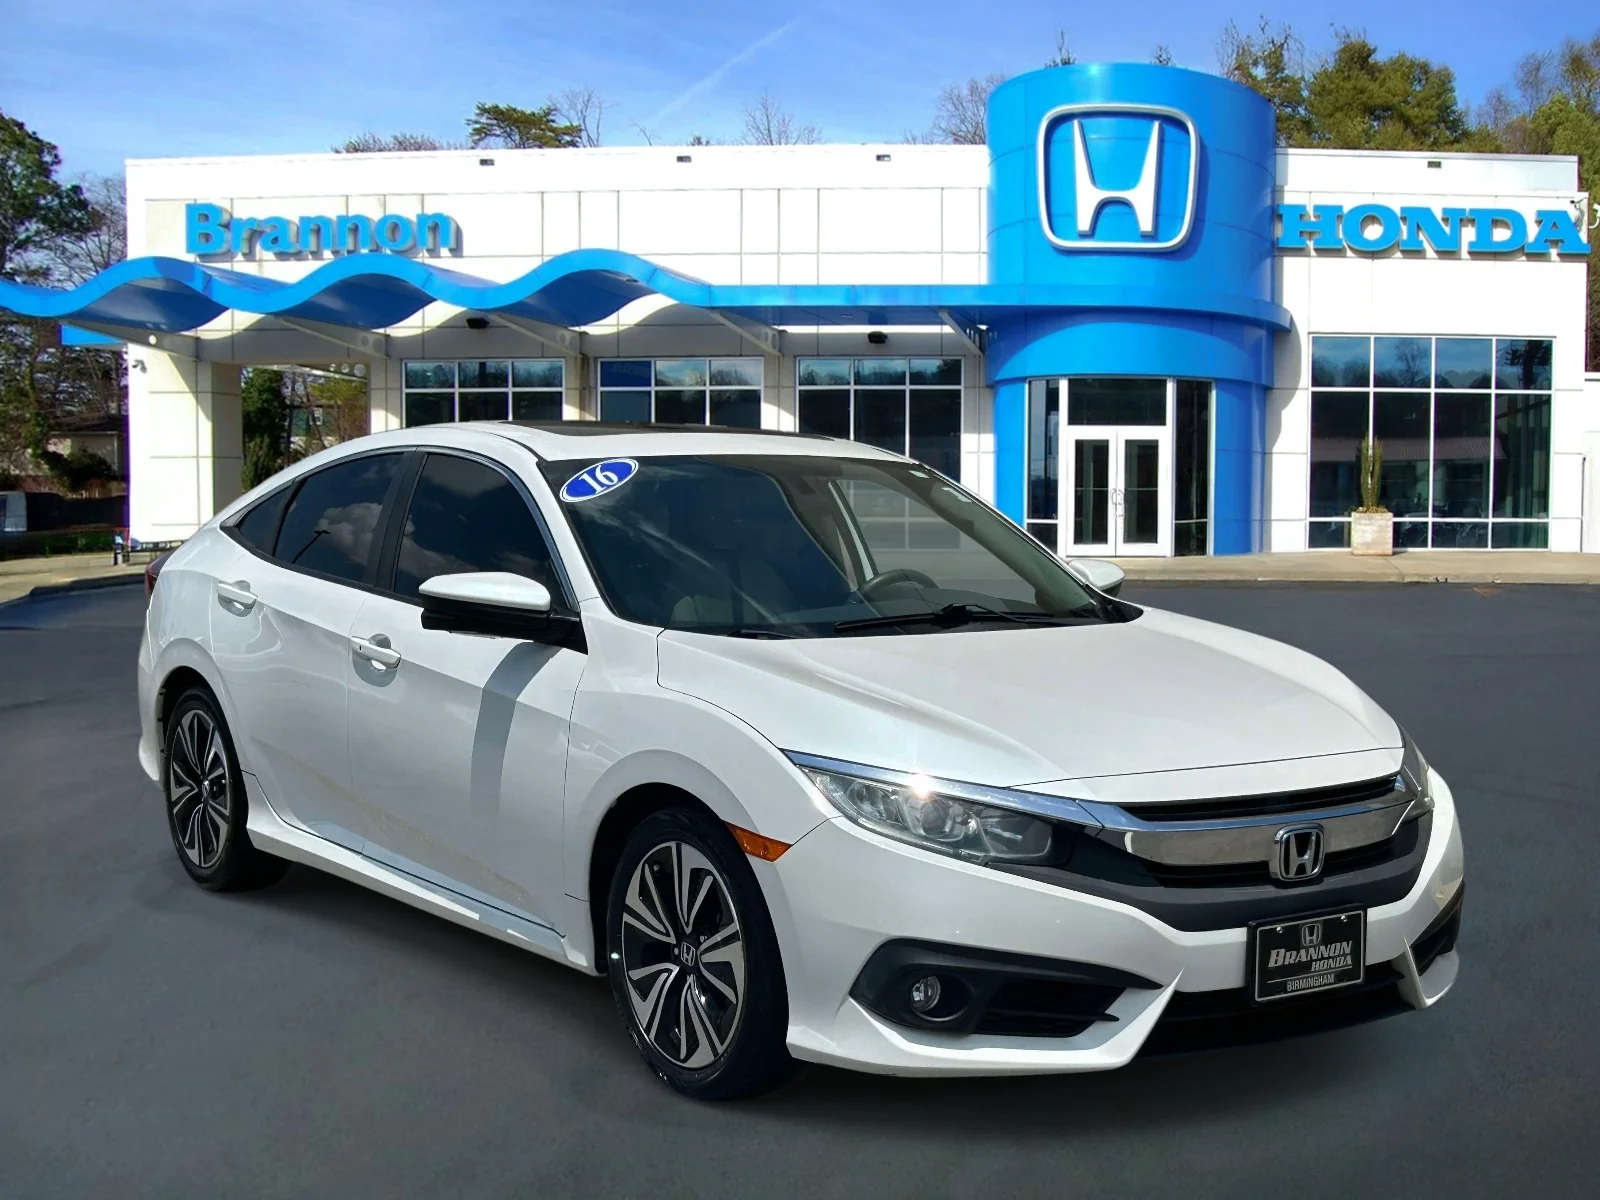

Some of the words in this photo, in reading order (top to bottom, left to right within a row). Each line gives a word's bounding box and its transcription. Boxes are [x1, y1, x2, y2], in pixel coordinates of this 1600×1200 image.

[185, 203, 459, 256] Brannon
[1277, 203, 1591, 257] HONDA
[579, 464, 618, 494] 16
[1268, 941, 1352, 968] BRANNON
[1310, 955, 1352, 972] HONDA
[1286, 974, 1335, 991] BIRMINGHAM
